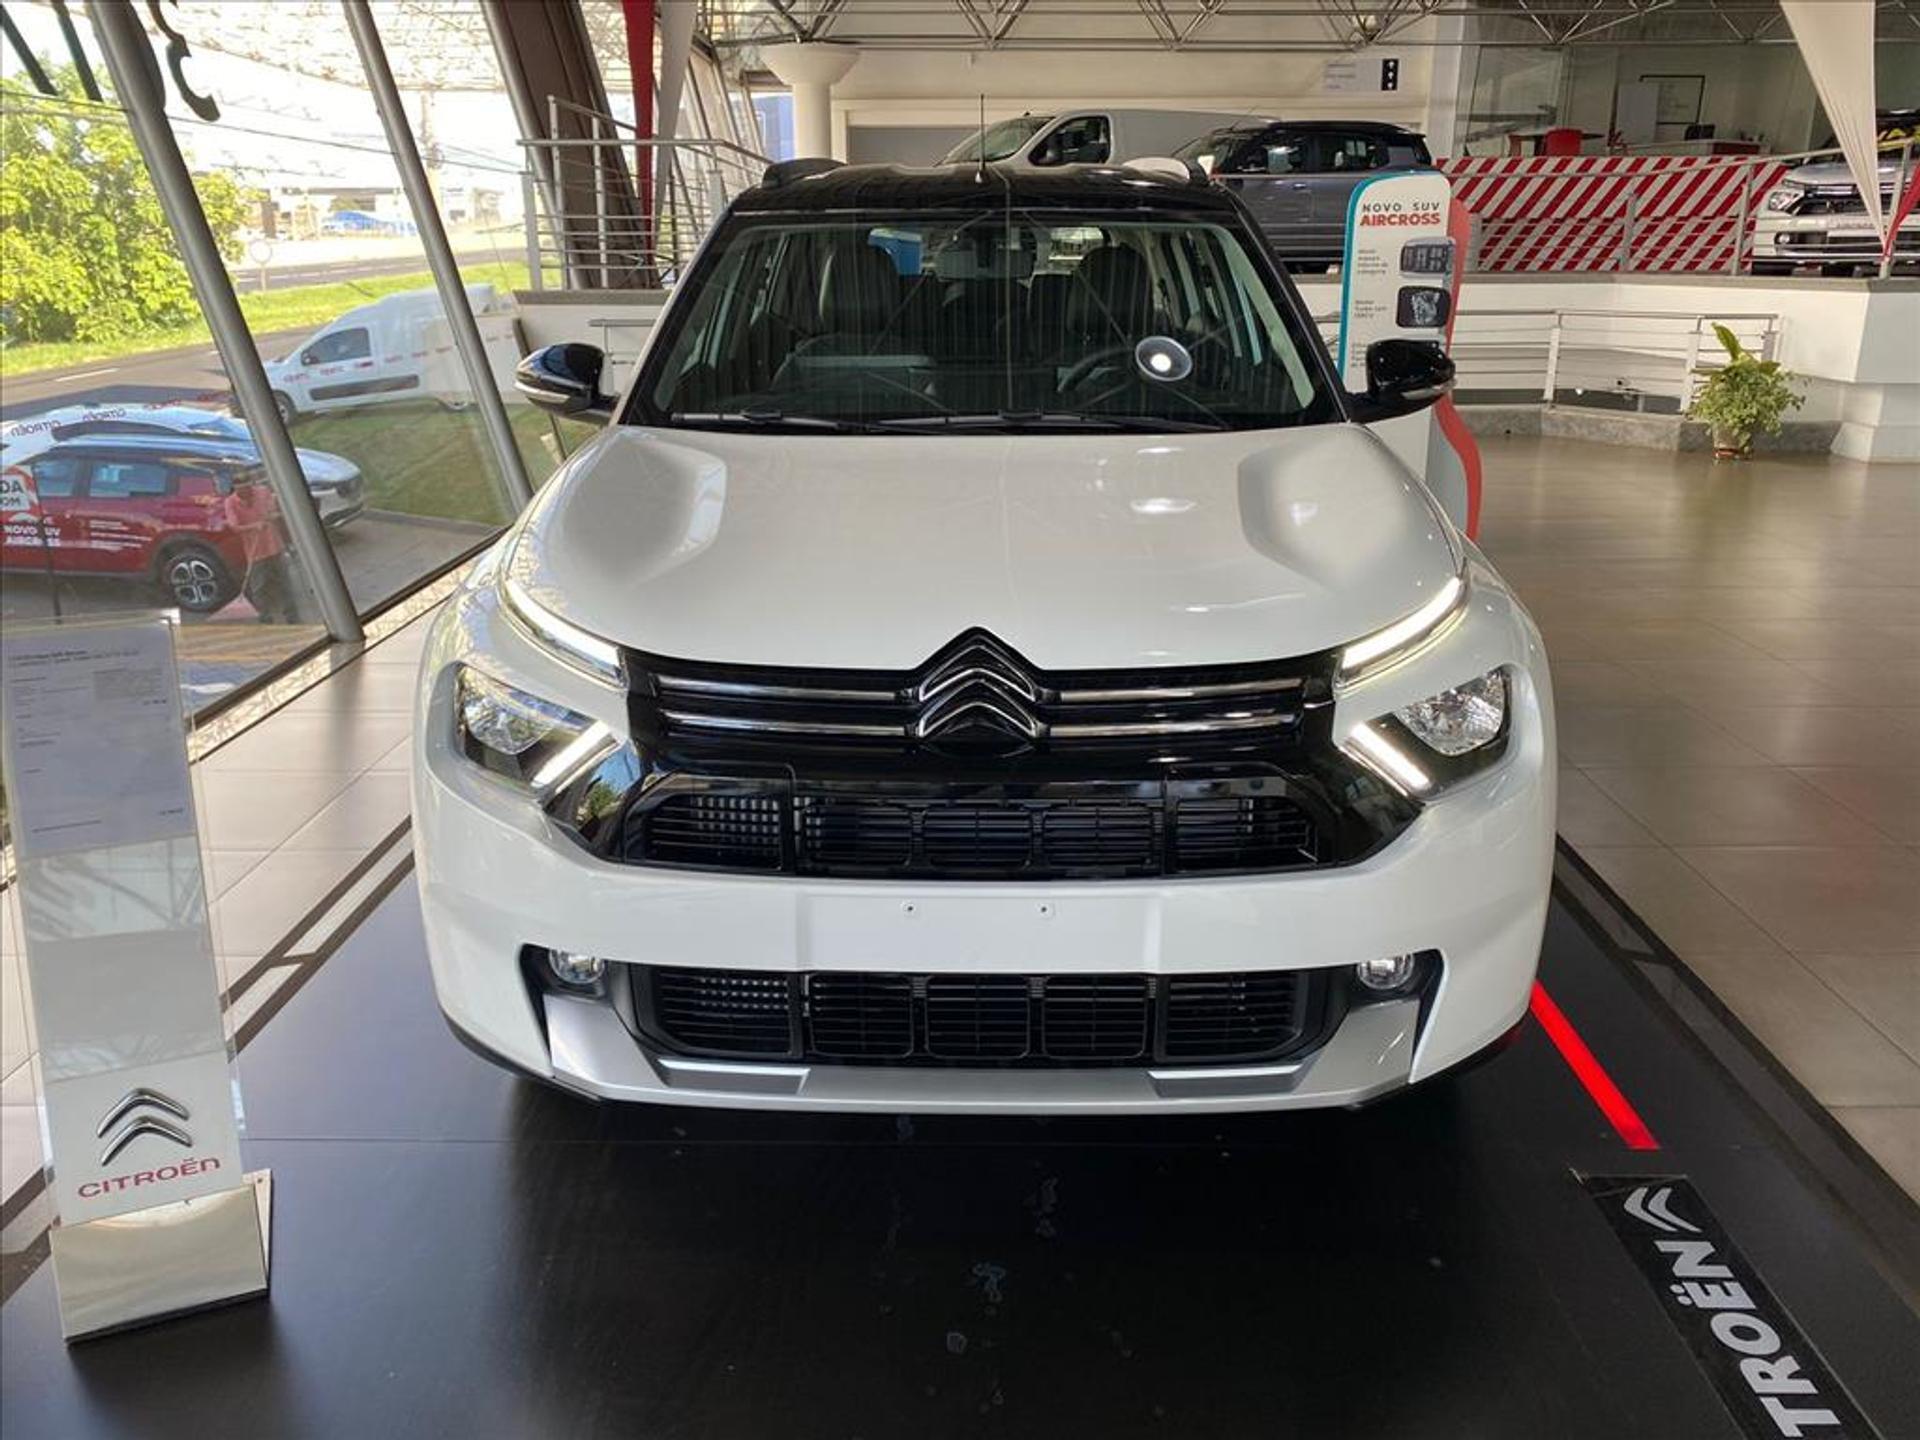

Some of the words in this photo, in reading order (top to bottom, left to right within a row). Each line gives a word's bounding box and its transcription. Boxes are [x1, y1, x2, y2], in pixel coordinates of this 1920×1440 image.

[1362, 203, 1402, 212] NOVO
[1413, 202, 1440, 211] SUV
[1360, 213, 1441, 226] AIRCROSS
